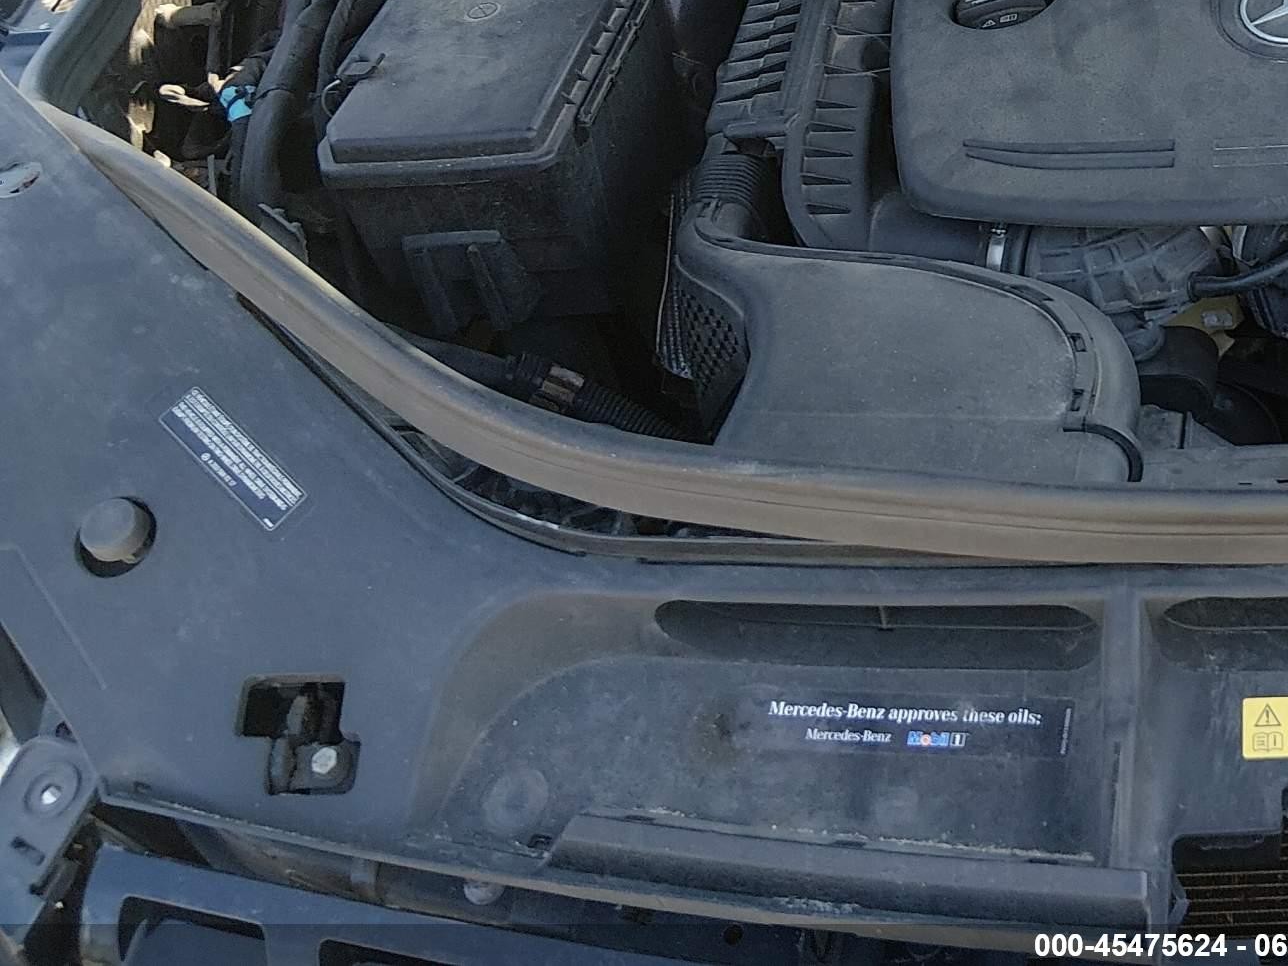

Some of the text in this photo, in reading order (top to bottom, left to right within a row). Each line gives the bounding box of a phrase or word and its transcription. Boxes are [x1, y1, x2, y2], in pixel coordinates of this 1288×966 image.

[767, 700, 886, 720] Mercedes-Benz
[887, 707, 958, 724] approves
[962, 708, 1005, 724] these
[804, 727, 892, 743] Mercedes-Benz
